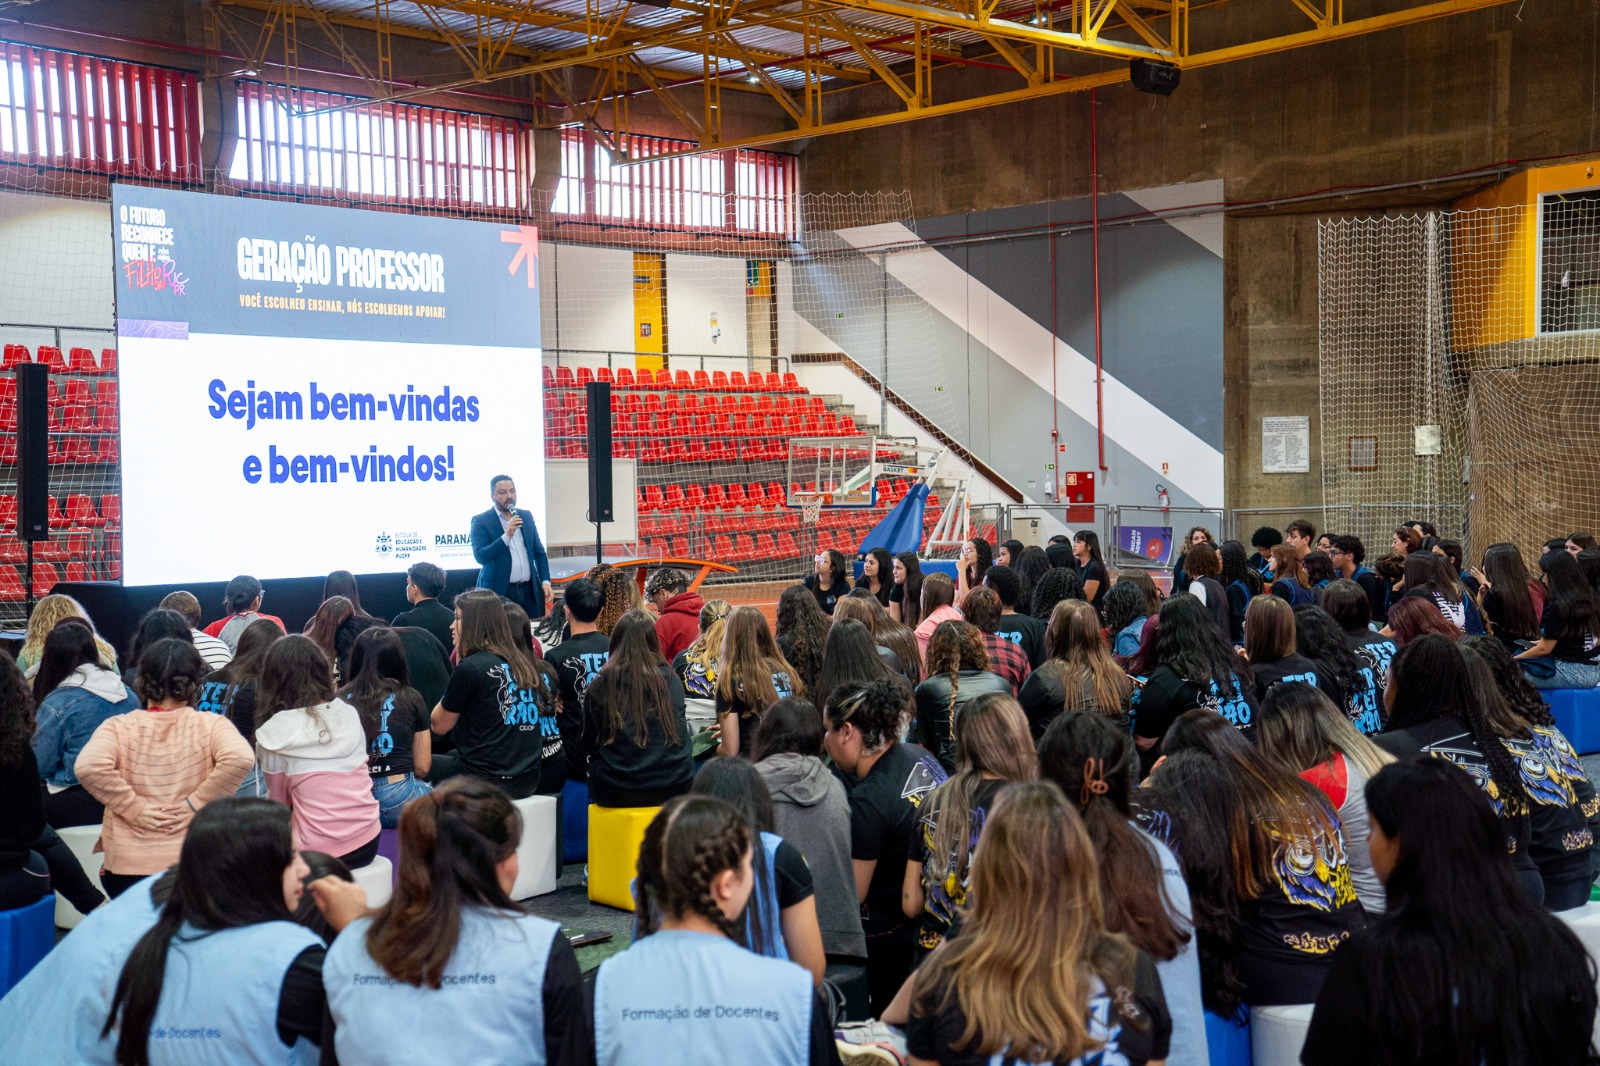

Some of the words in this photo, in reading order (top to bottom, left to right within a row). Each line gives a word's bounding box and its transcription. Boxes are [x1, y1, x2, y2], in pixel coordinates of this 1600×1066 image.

[120, 205, 128, 223] O
[129, 206, 166, 227] FUTURO
[121, 223, 174, 246] RECONHECE
[121, 242, 149, 262] QUEM
[237, 234, 332, 293] GERAÇÃO
[335, 245, 445, 293] PROFESSOR
[239, 292, 262, 307] VOCÊ
[263, 295, 306, 311] ESCOLHEU
[308, 298, 345, 315] ENSINAR,
[346, 298, 363, 314] NÓS
[364, 302, 414, 317] ESCOLHEMOS
[415, 305, 446, 318] APOIAR!
[208, 378, 304, 431] Sejam
[310, 381, 480, 422] bem-vindas
[242, 454, 262, 485] e
[268, 445, 455, 484] bem-vindos!
[1365, 641, 1397, 661] TER
[353, 973, 395, 988] Formaç
[622, 1005, 689, 1023] Formação
[694, 1006, 711, 1019] de
[715, 1005, 779, 1022] Docentes
[168, 1026, 221, 1039] Docentes
